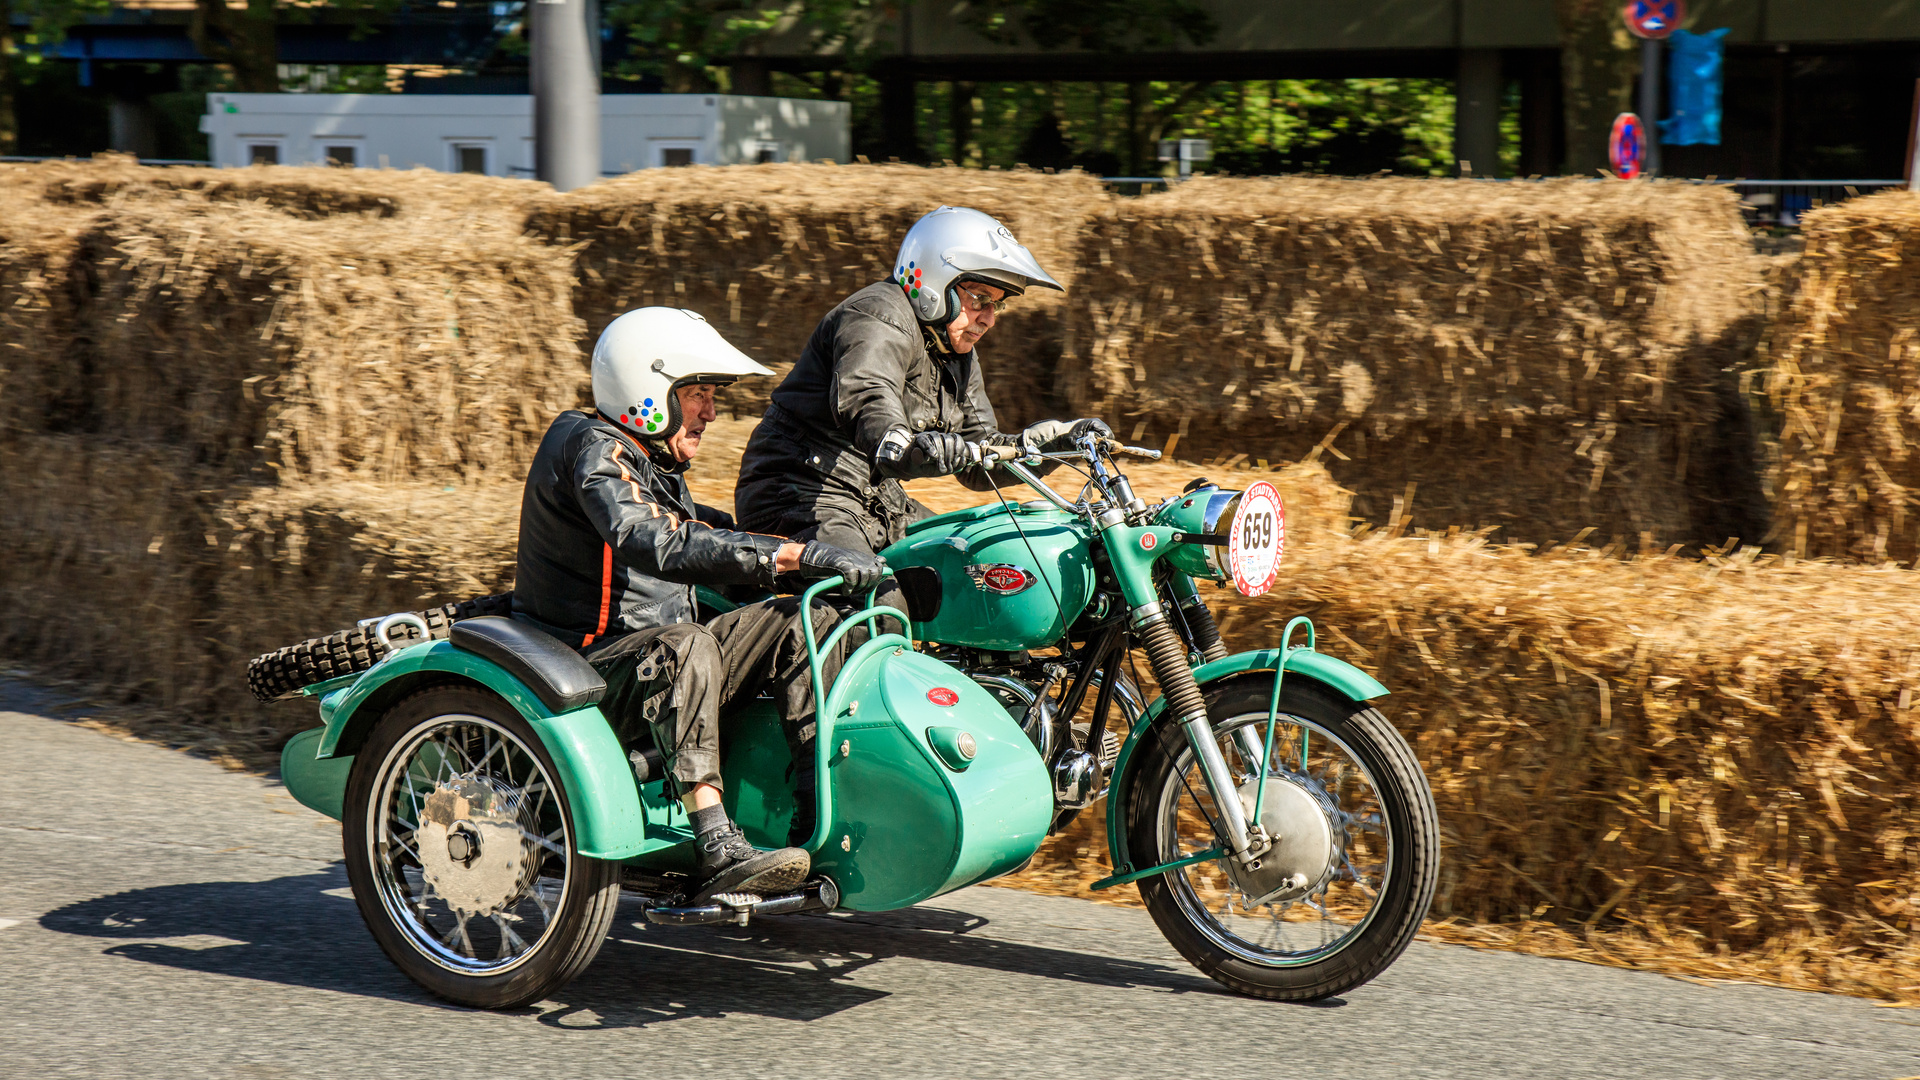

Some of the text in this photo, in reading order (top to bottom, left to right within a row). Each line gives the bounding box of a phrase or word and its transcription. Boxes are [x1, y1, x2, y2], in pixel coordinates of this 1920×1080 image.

[1232, 485, 1284, 582] HAMBURGER STADTPARK-REVIVAL
[1243, 511, 1272, 550] 659
[1248, 586, 1264, 597] 2017
